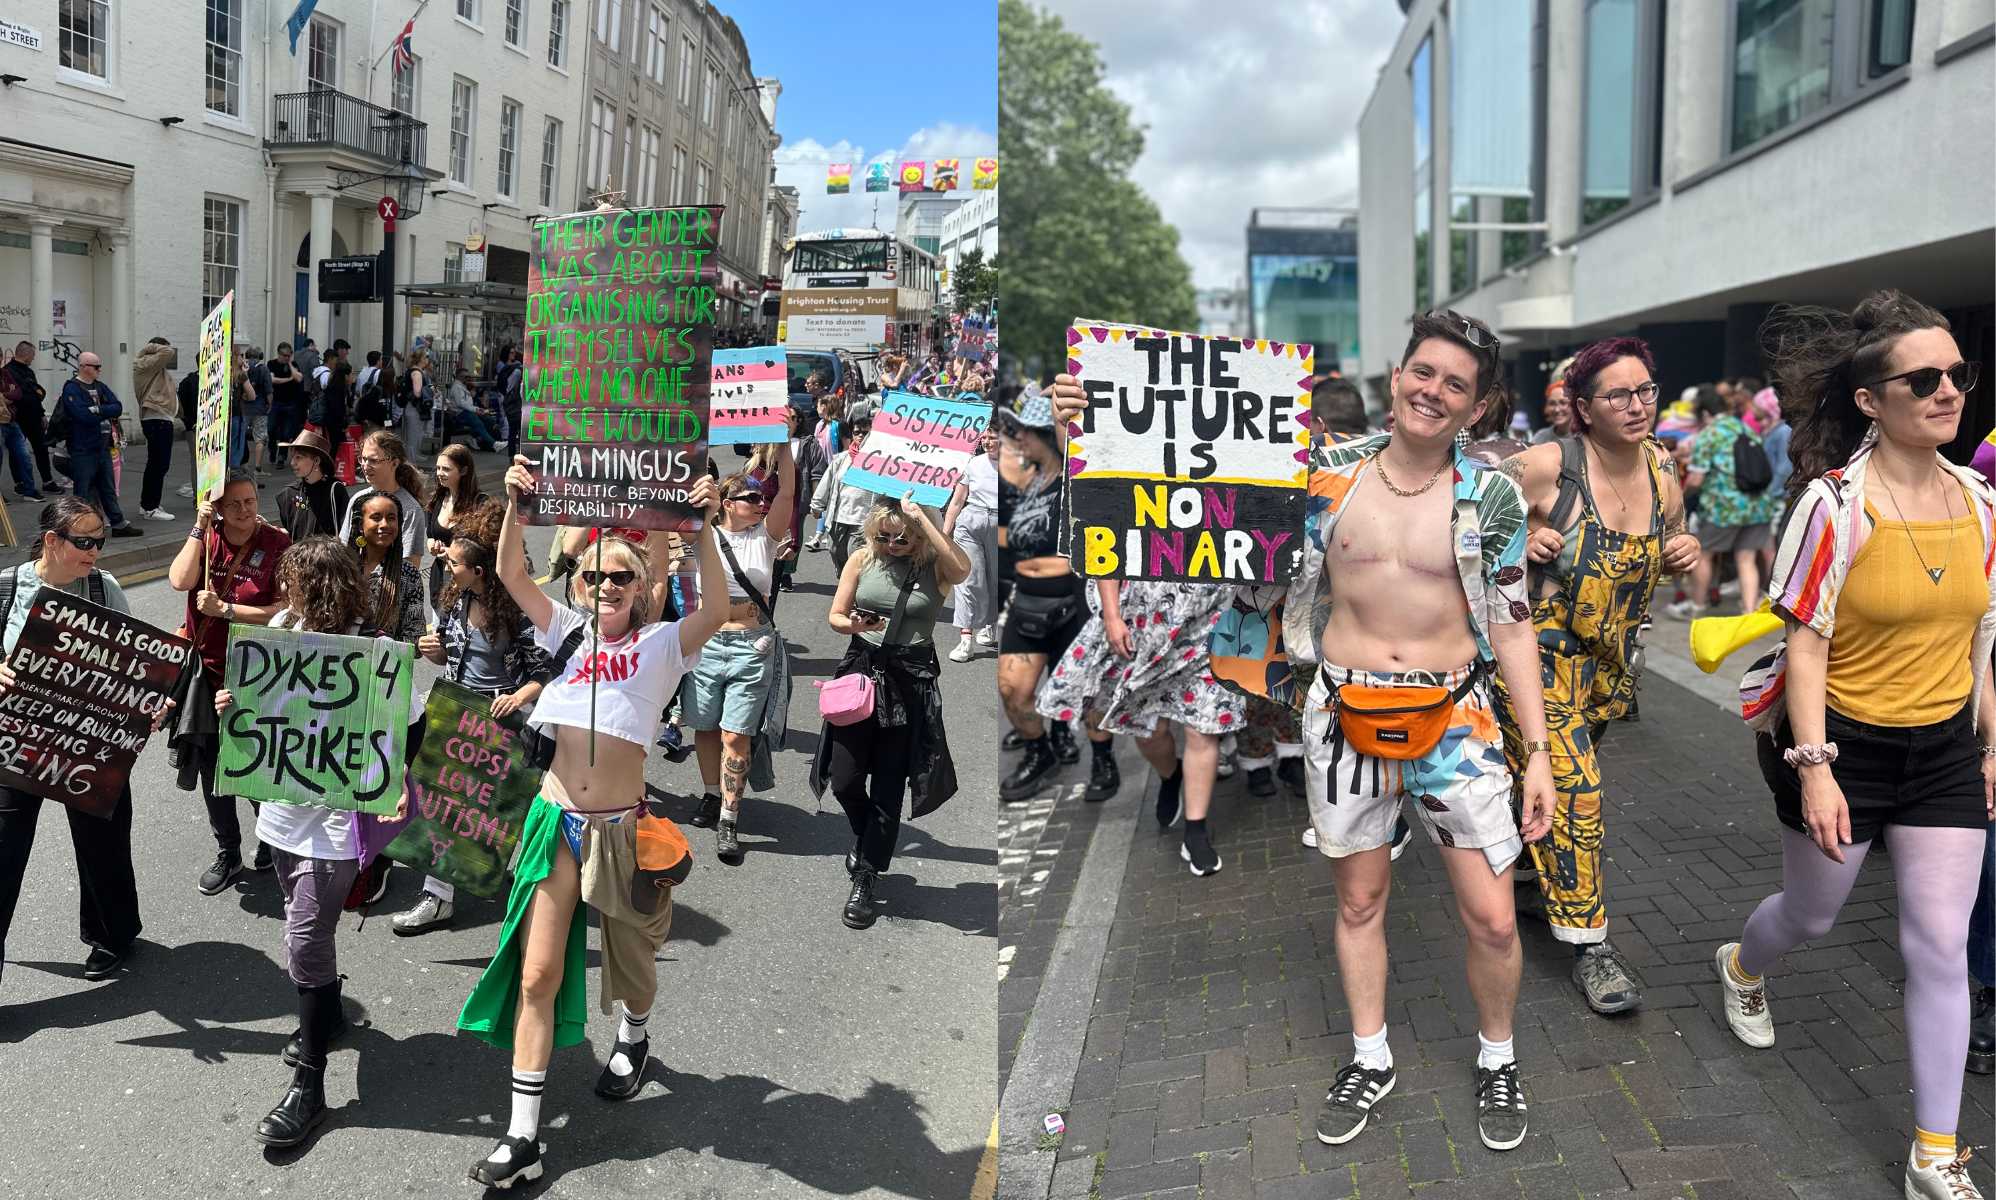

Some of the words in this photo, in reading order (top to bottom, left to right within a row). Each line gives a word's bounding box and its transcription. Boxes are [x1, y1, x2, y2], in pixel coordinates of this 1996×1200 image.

[11, 31, 39, 48] STREET
[383, 202, 394, 217] X
[613, 208, 714, 248] GENDER
[540, 252, 598, 288] WAS
[608, 250, 711, 285] ABOUT
[673, 285, 716, 325] FOR
[788, 297, 824, 306] Brighton
[827, 296, 864, 306] Housing
[867, 296, 889, 304] Trust
[208, 312, 222, 336] FUCK
[202, 330, 224, 364] CULTURE
[527, 327, 697, 365] THEMSELVES
[1134, 336, 1241, 388] THE
[523, 366, 591, 405] WHEN
[600, 366, 635, 405] NO
[641, 366, 692, 405] ONE
[714, 365, 744, 379] ANS
[200, 377, 223, 406] ECONOMIC
[200, 397, 222, 431] JUSTICE
[527, 407, 595, 441] ELSE
[603, 408, 701, 442] WOULD
[714, 407, 770, 418] ATTER
[889, 404, 985, 443] SISTERS
[1083, 380, 1294, 443] FUTURE
[200, 433, 210, 460] FOR
[1164, 442, 1218, 480] IS
[628, 486, 689, 503] BEYOND
[1134, 485, 1238, 529] NON
[1084, 526, 1293, 582] BINARY
[40, 600, 110, 640] SMALL
[54, 632, 120, 672] SMALL
[12, 648, 168, 714] EVERYTHING!
[15, 680, 53, 697] DRIENNE
[235, 640, 365, 710] DYKES
[375, 650, 401, 699] 4
[0, 693, 54, 718] KEEP
[54, 709, 81, 727] ON
[458, 710, 517, 751] HATE
[94, 745, 112, 763] &
[445, 737, 512, 780] COPS!
[439, 766, 494, 806] LOVE
